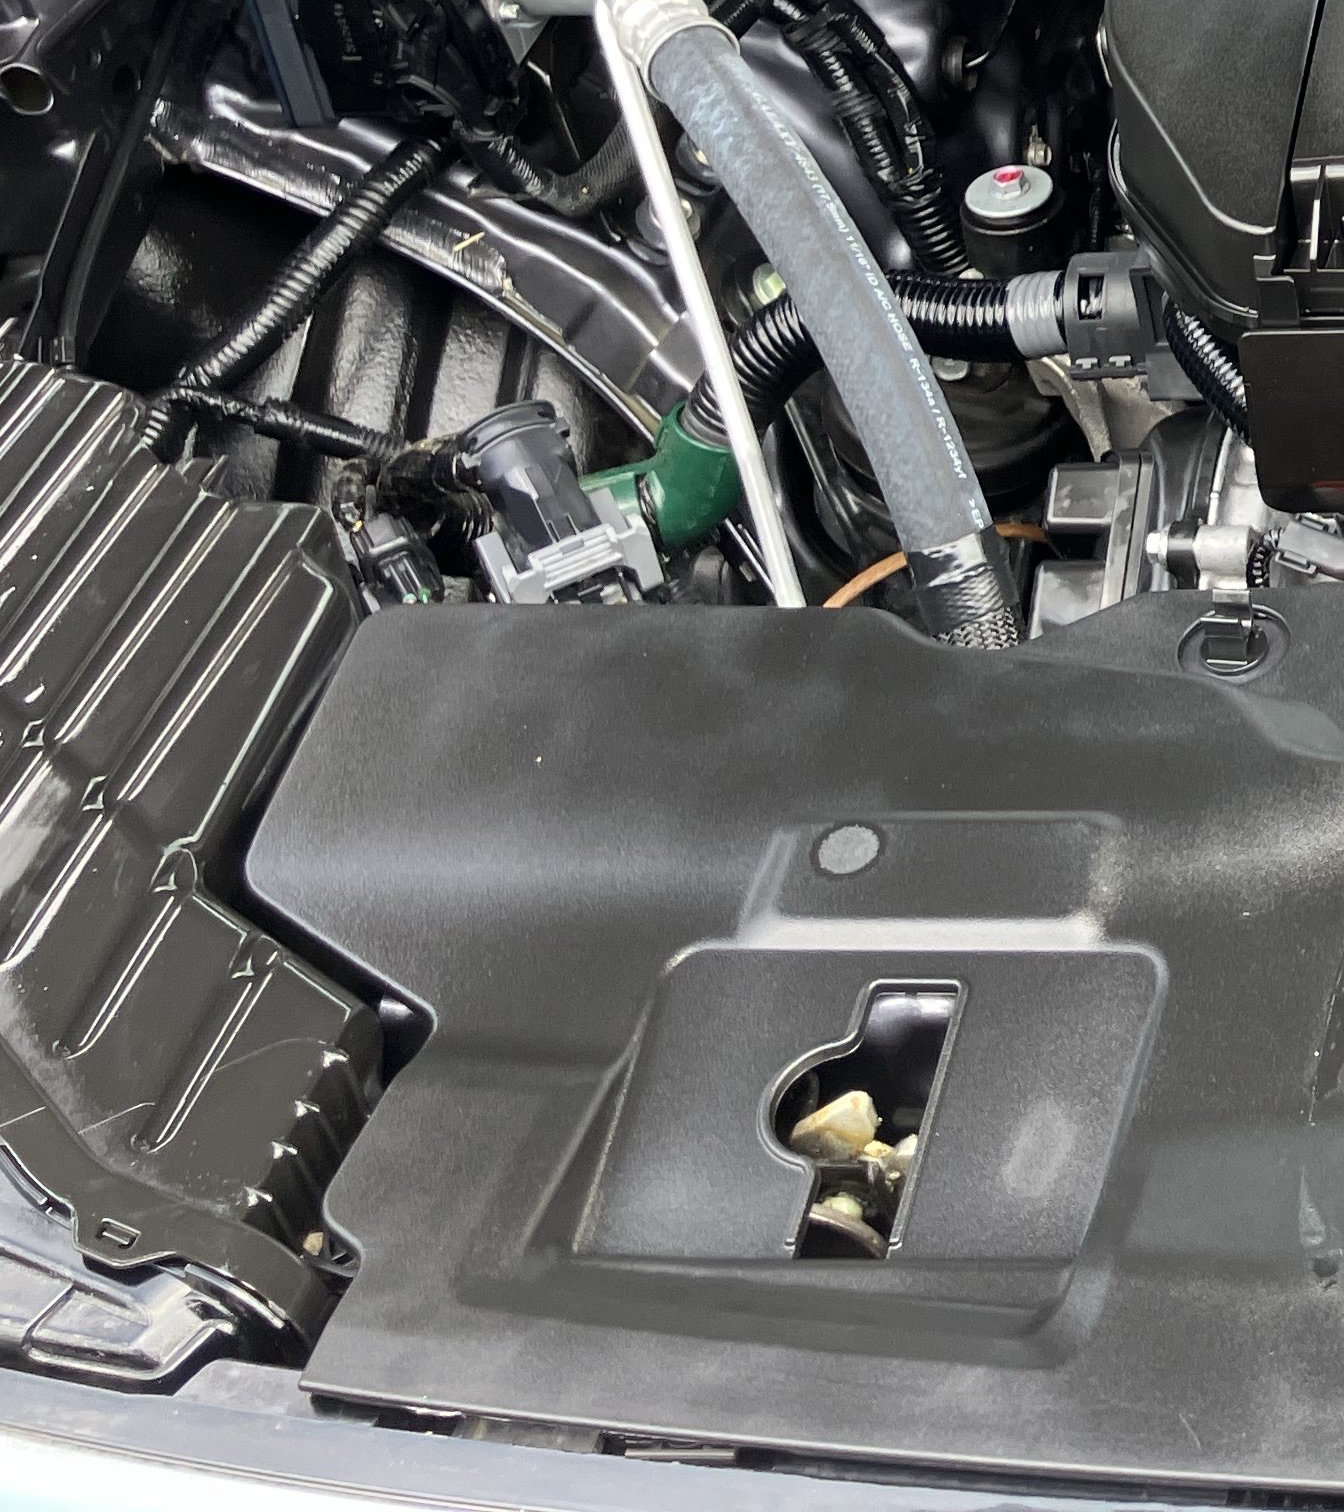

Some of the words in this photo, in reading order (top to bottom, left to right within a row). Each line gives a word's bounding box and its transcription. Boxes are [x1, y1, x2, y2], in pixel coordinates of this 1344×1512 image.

[866, 272, 879, 286] ID
[873, 288, 892, 311] A/C
[887, 313, 913, 351] HOSE
[910, 358, 936, 406] R-134a
[936, 416, 967, 479] R-1234yf
